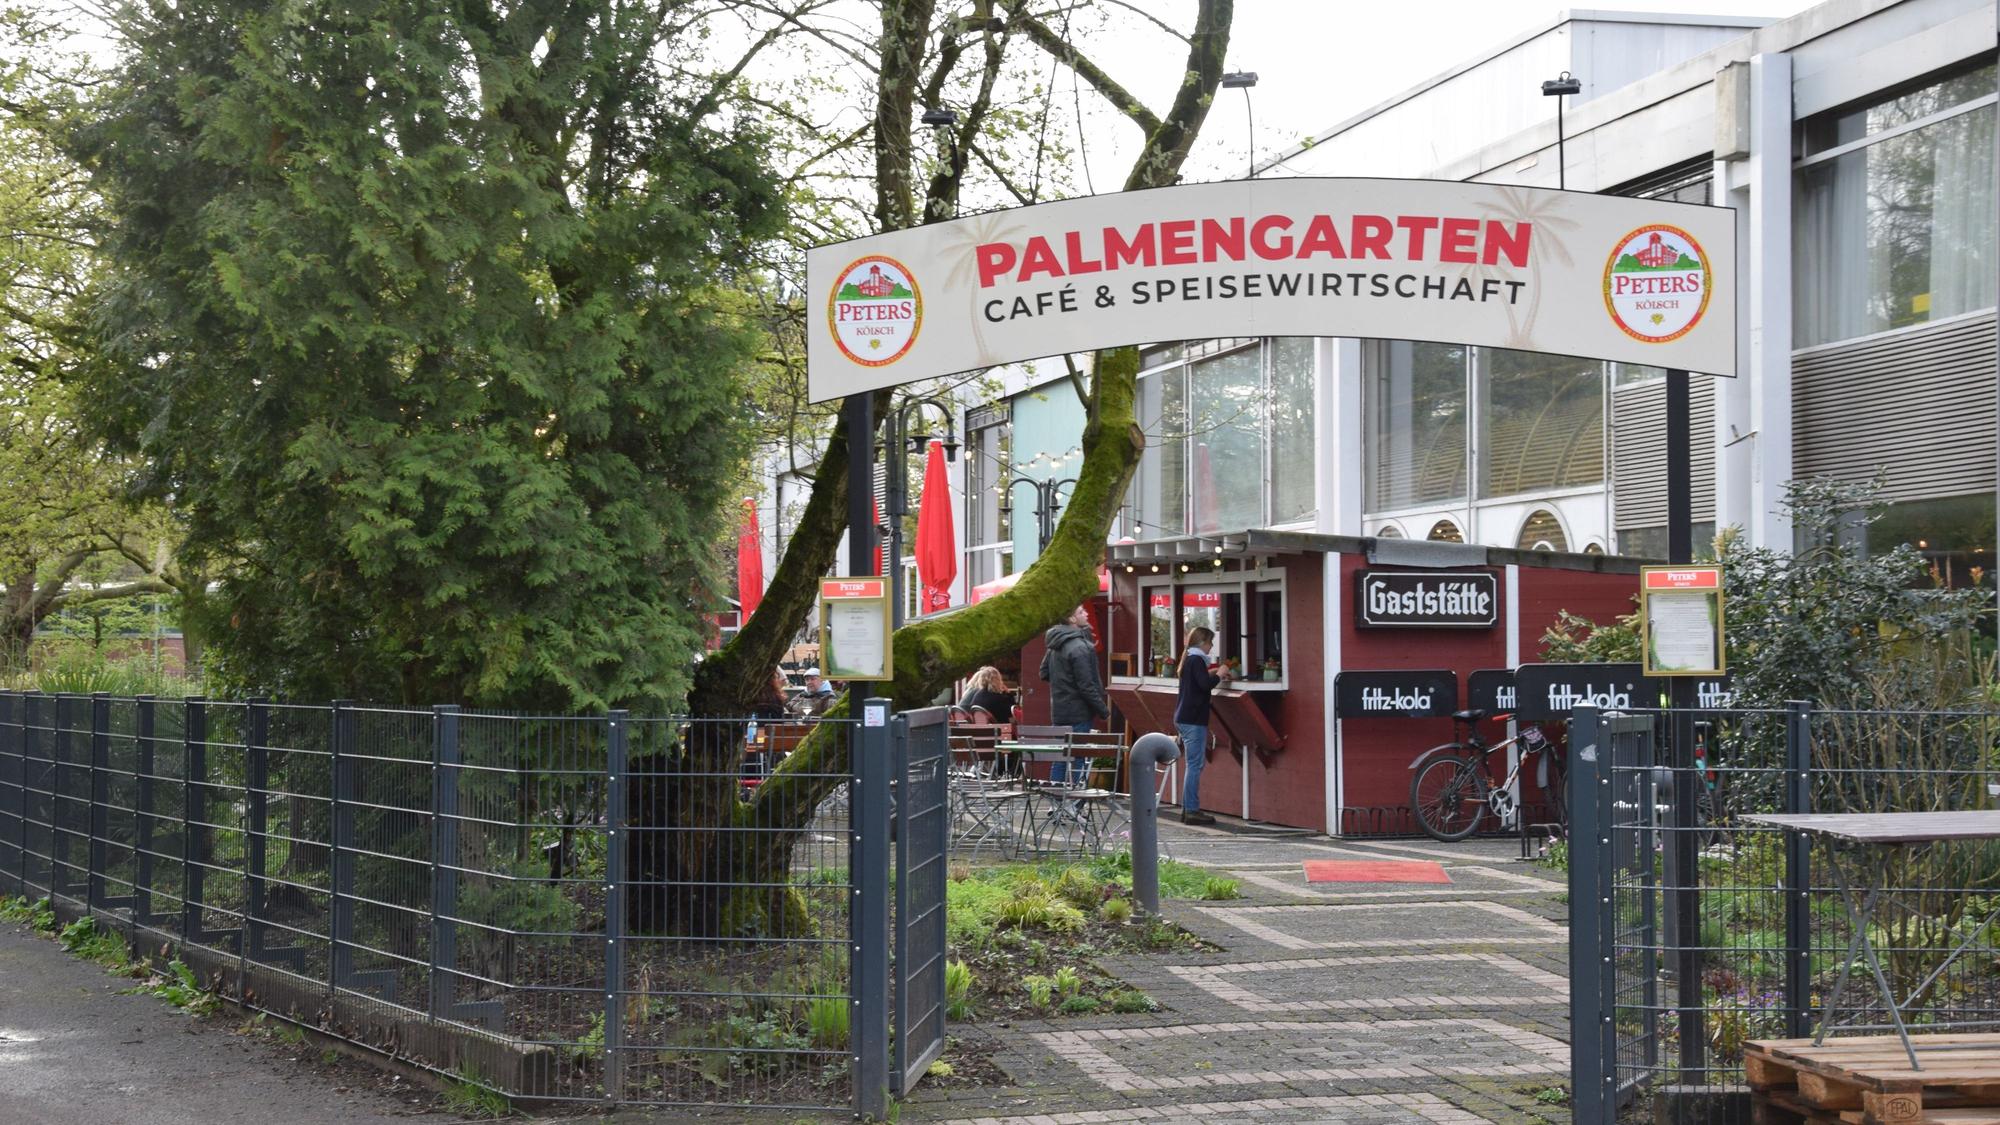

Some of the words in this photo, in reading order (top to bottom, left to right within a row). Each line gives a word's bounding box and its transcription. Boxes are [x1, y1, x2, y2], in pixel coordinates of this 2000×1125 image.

[976, 214, 1531, 287] PALMENGARTEN
[985, 282, 1077, 323] CAFÉ
[1095, 285, 1115, 308] &
[1132, 272, 1526, 305] SPEISEWIRTSCHAFT
[1614, 273, 1700, 295] PETERS
[839, 302, 912, 321] PETERS
[1370, 581, 1490, 616] Gaststätte
[1362, 687, 1430, 710] fritz-kola
